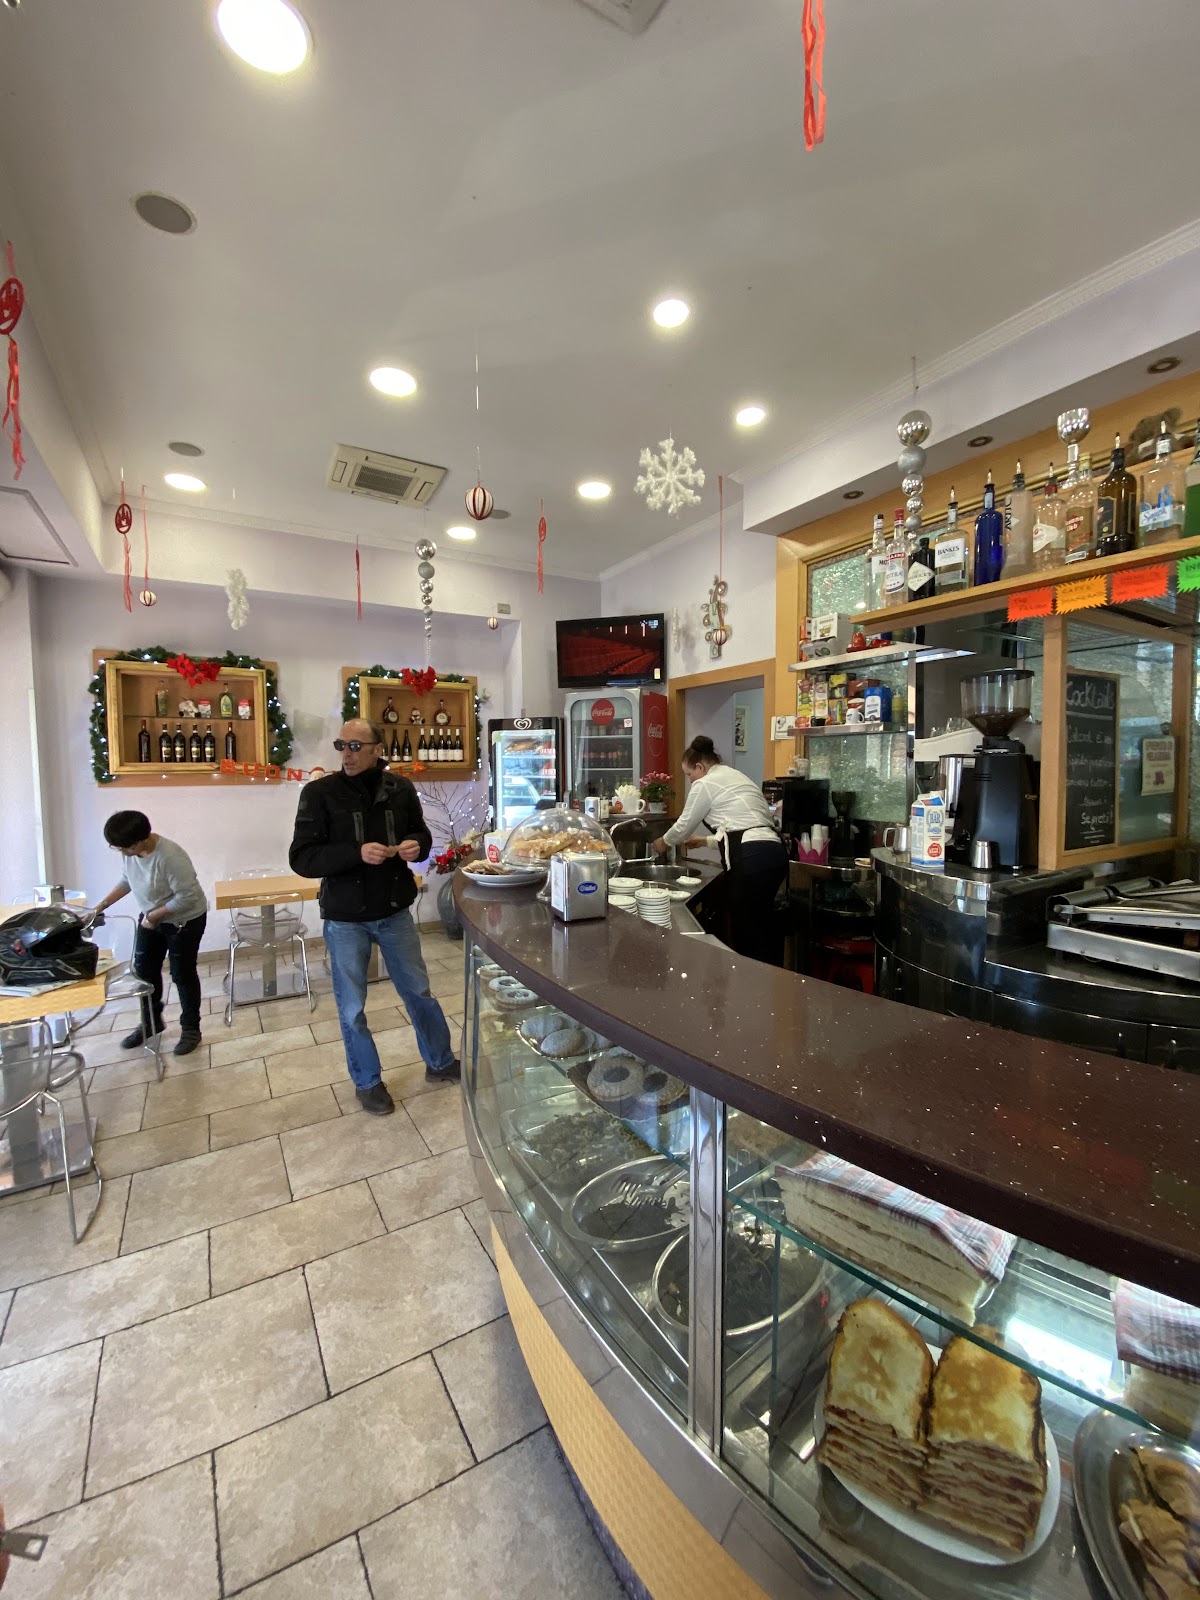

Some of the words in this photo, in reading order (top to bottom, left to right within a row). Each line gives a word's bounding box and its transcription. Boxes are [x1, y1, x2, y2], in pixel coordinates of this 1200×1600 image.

[937, 545, 960, 556] BANKES
[592, 708, 613, 716] Coca-Cola
[220, 758, 302, 781] BUON
